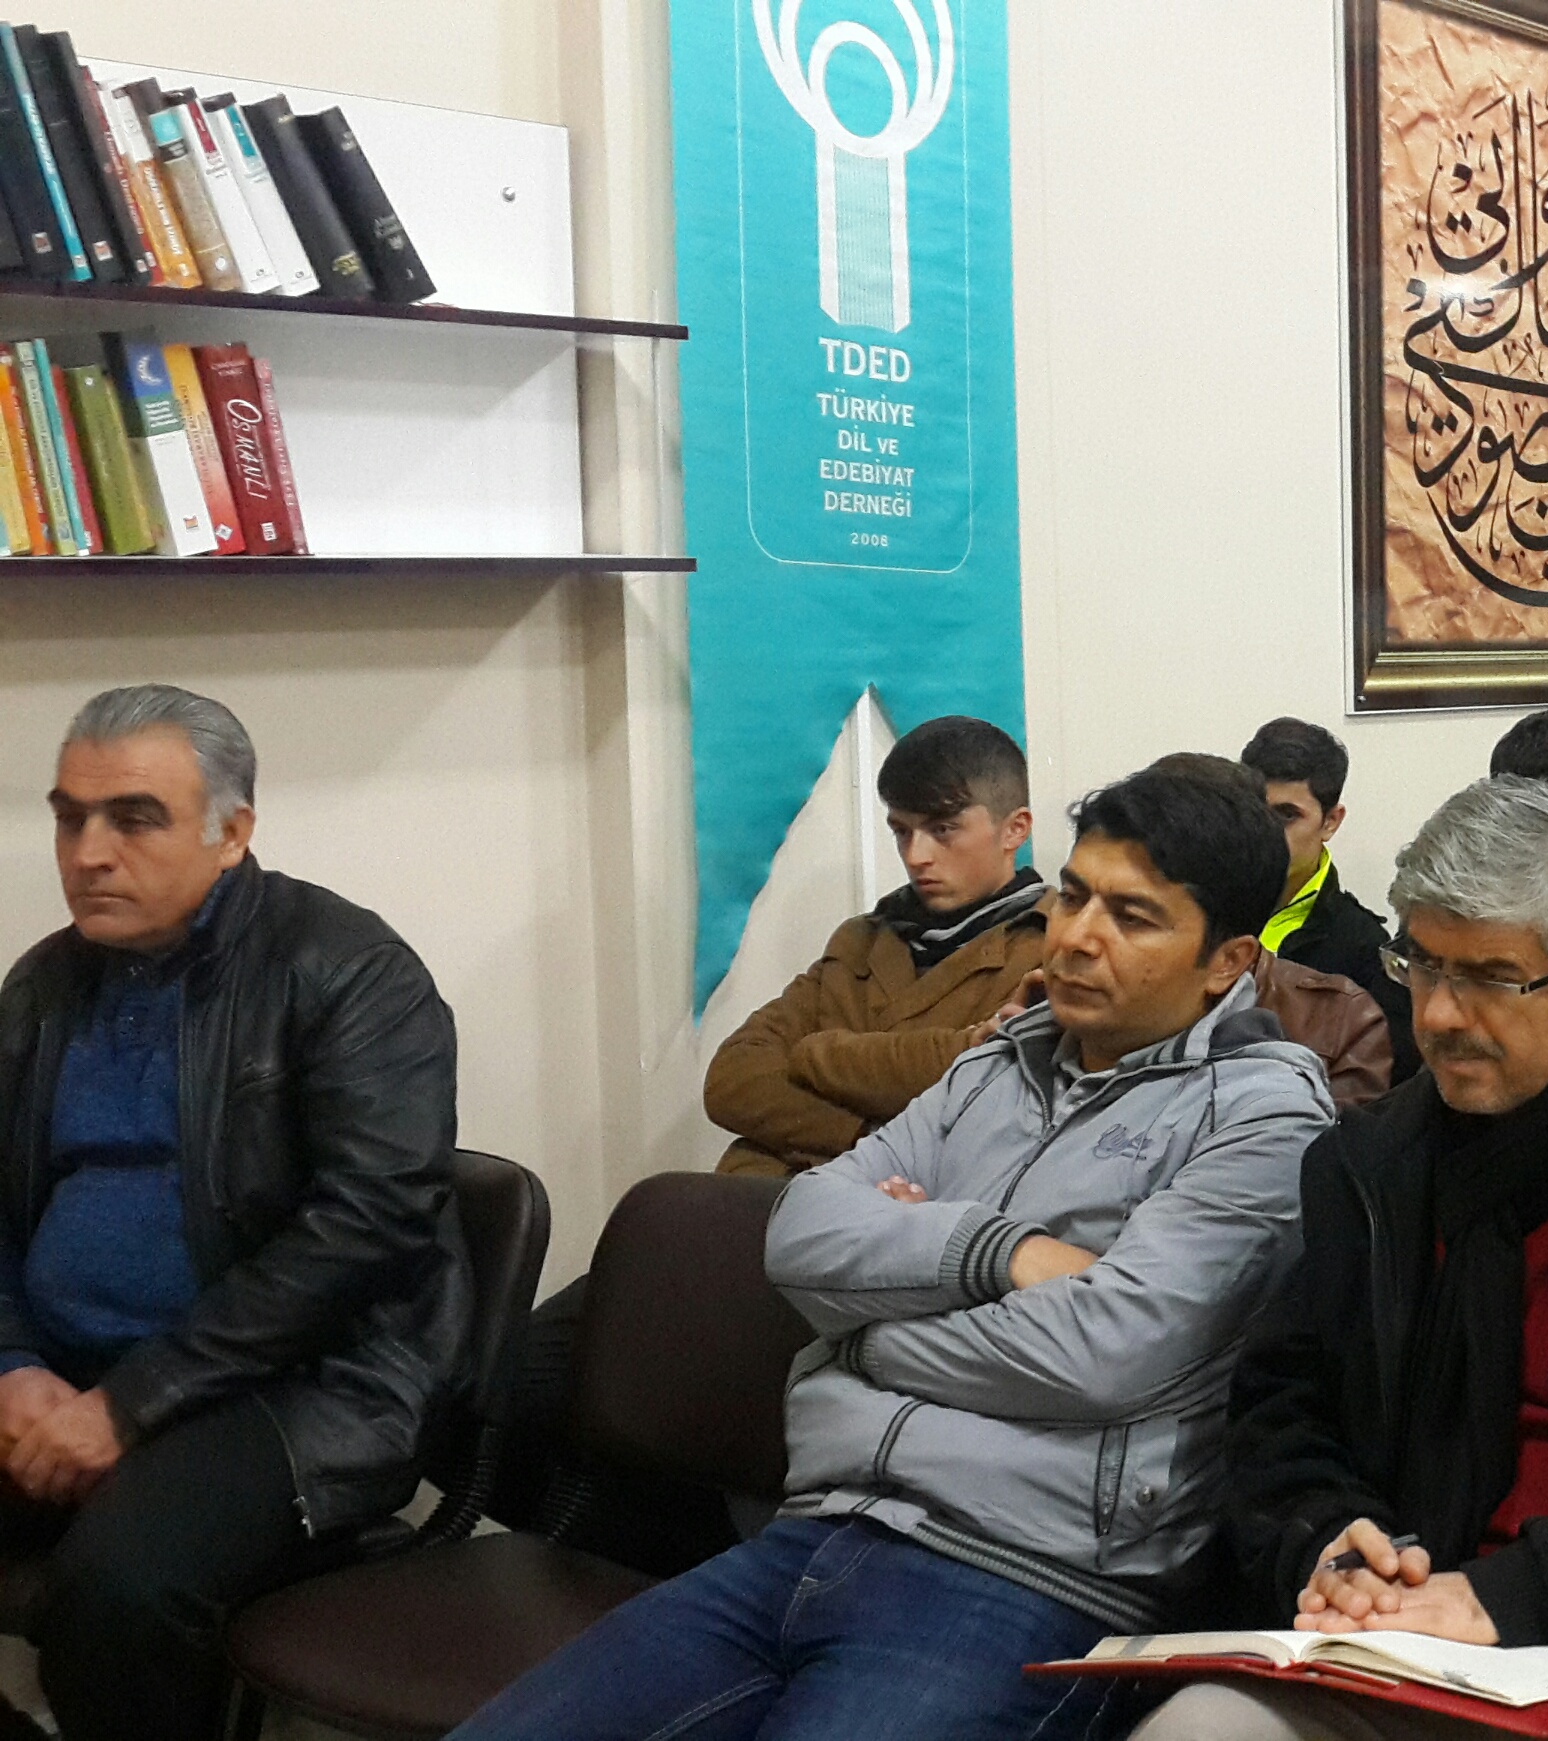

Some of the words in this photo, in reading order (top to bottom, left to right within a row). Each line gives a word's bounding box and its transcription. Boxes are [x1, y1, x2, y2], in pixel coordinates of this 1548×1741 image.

[818, 337, 911, 383] TDED
[816, 387, 915, 427] TÜRKİYE
[227, 399, 268, 500] OSMANLI
[838, 425, 872, 454] DİL
[877, 437, 899, 456] VE
[819, 458, 915, 487] EDEBİYAT
[824, 490, 912, 517] DERNEĞİ
